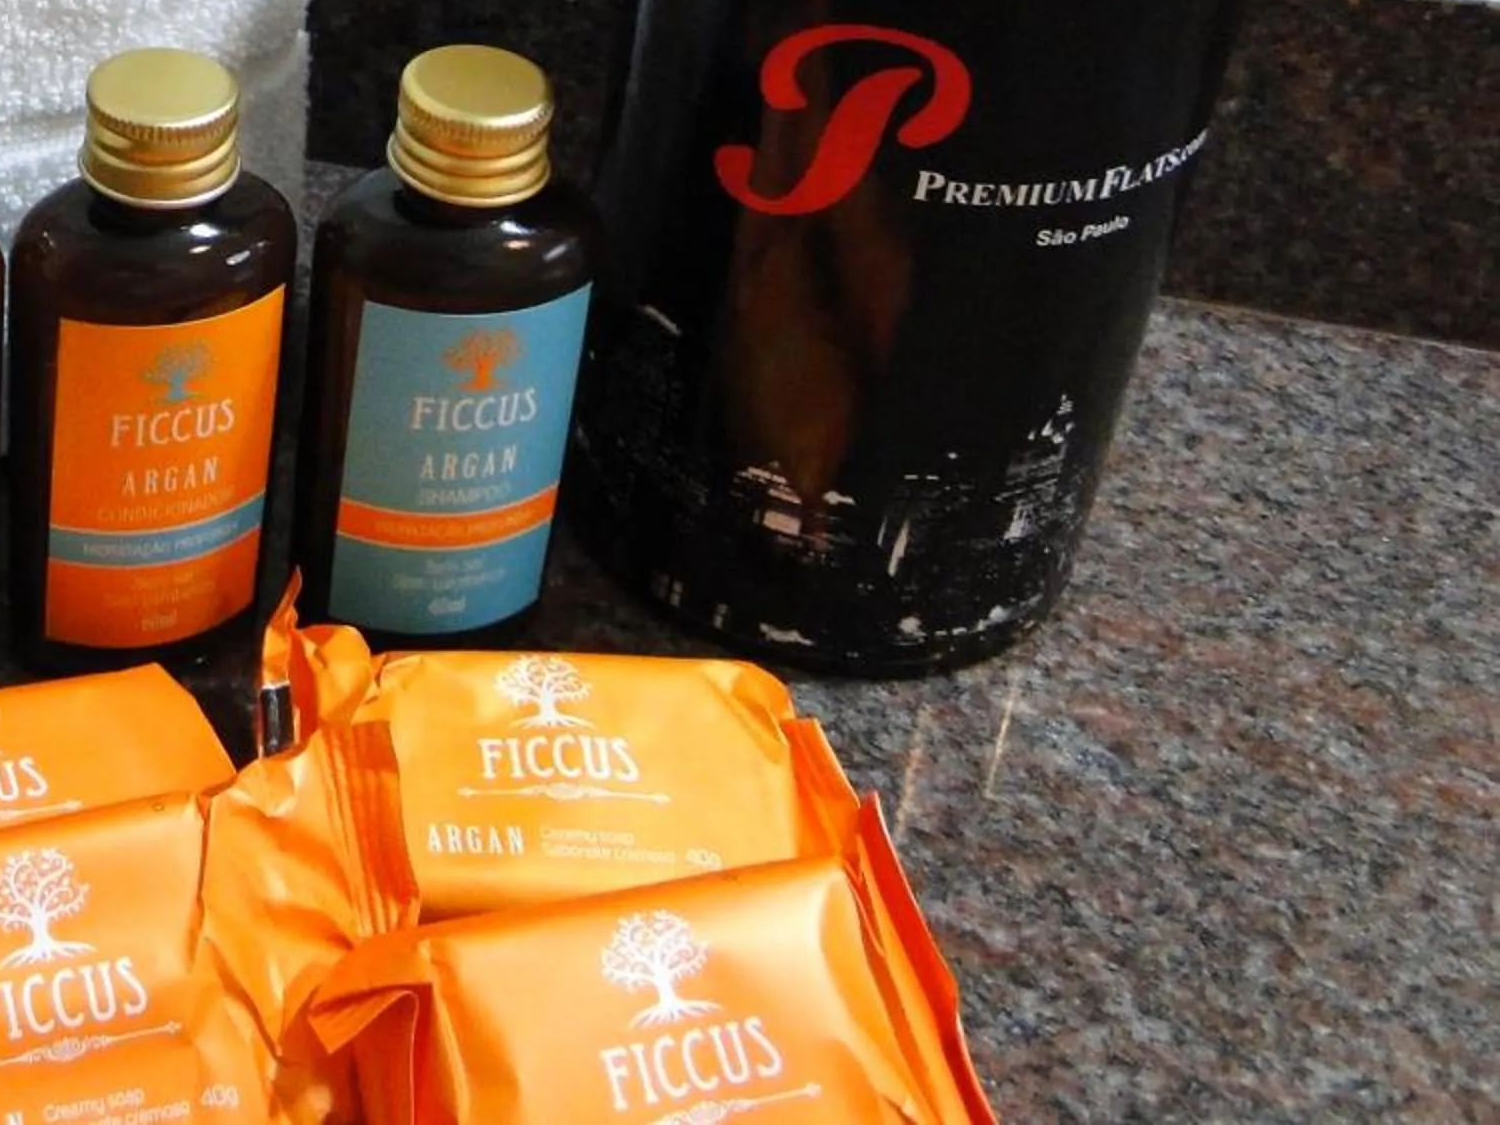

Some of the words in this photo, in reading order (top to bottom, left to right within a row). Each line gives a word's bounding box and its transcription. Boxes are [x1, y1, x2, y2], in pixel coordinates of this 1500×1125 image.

[714, 24, 972, 215] P
[1035, 227, 1076, 247] São
[1081, 215, 1130, 241] Paulo
[111, 398, 235, 448] FICCUS
[411, 386, 537, 432] FICCUS
[122, 455, 220, 496] ARGAN
[420, 445, 518, 481] ARGAN
[477, 733, 640, 784] FICCUS
[427, 824, 525, 856] ARGAN
[600, 1016, 785, 1112] FICCUS
[43, 1095, 105, 1122] Creamy
[108, 1087, 146, 1112] soap
[200, 1083, 240, 1109] 40g
